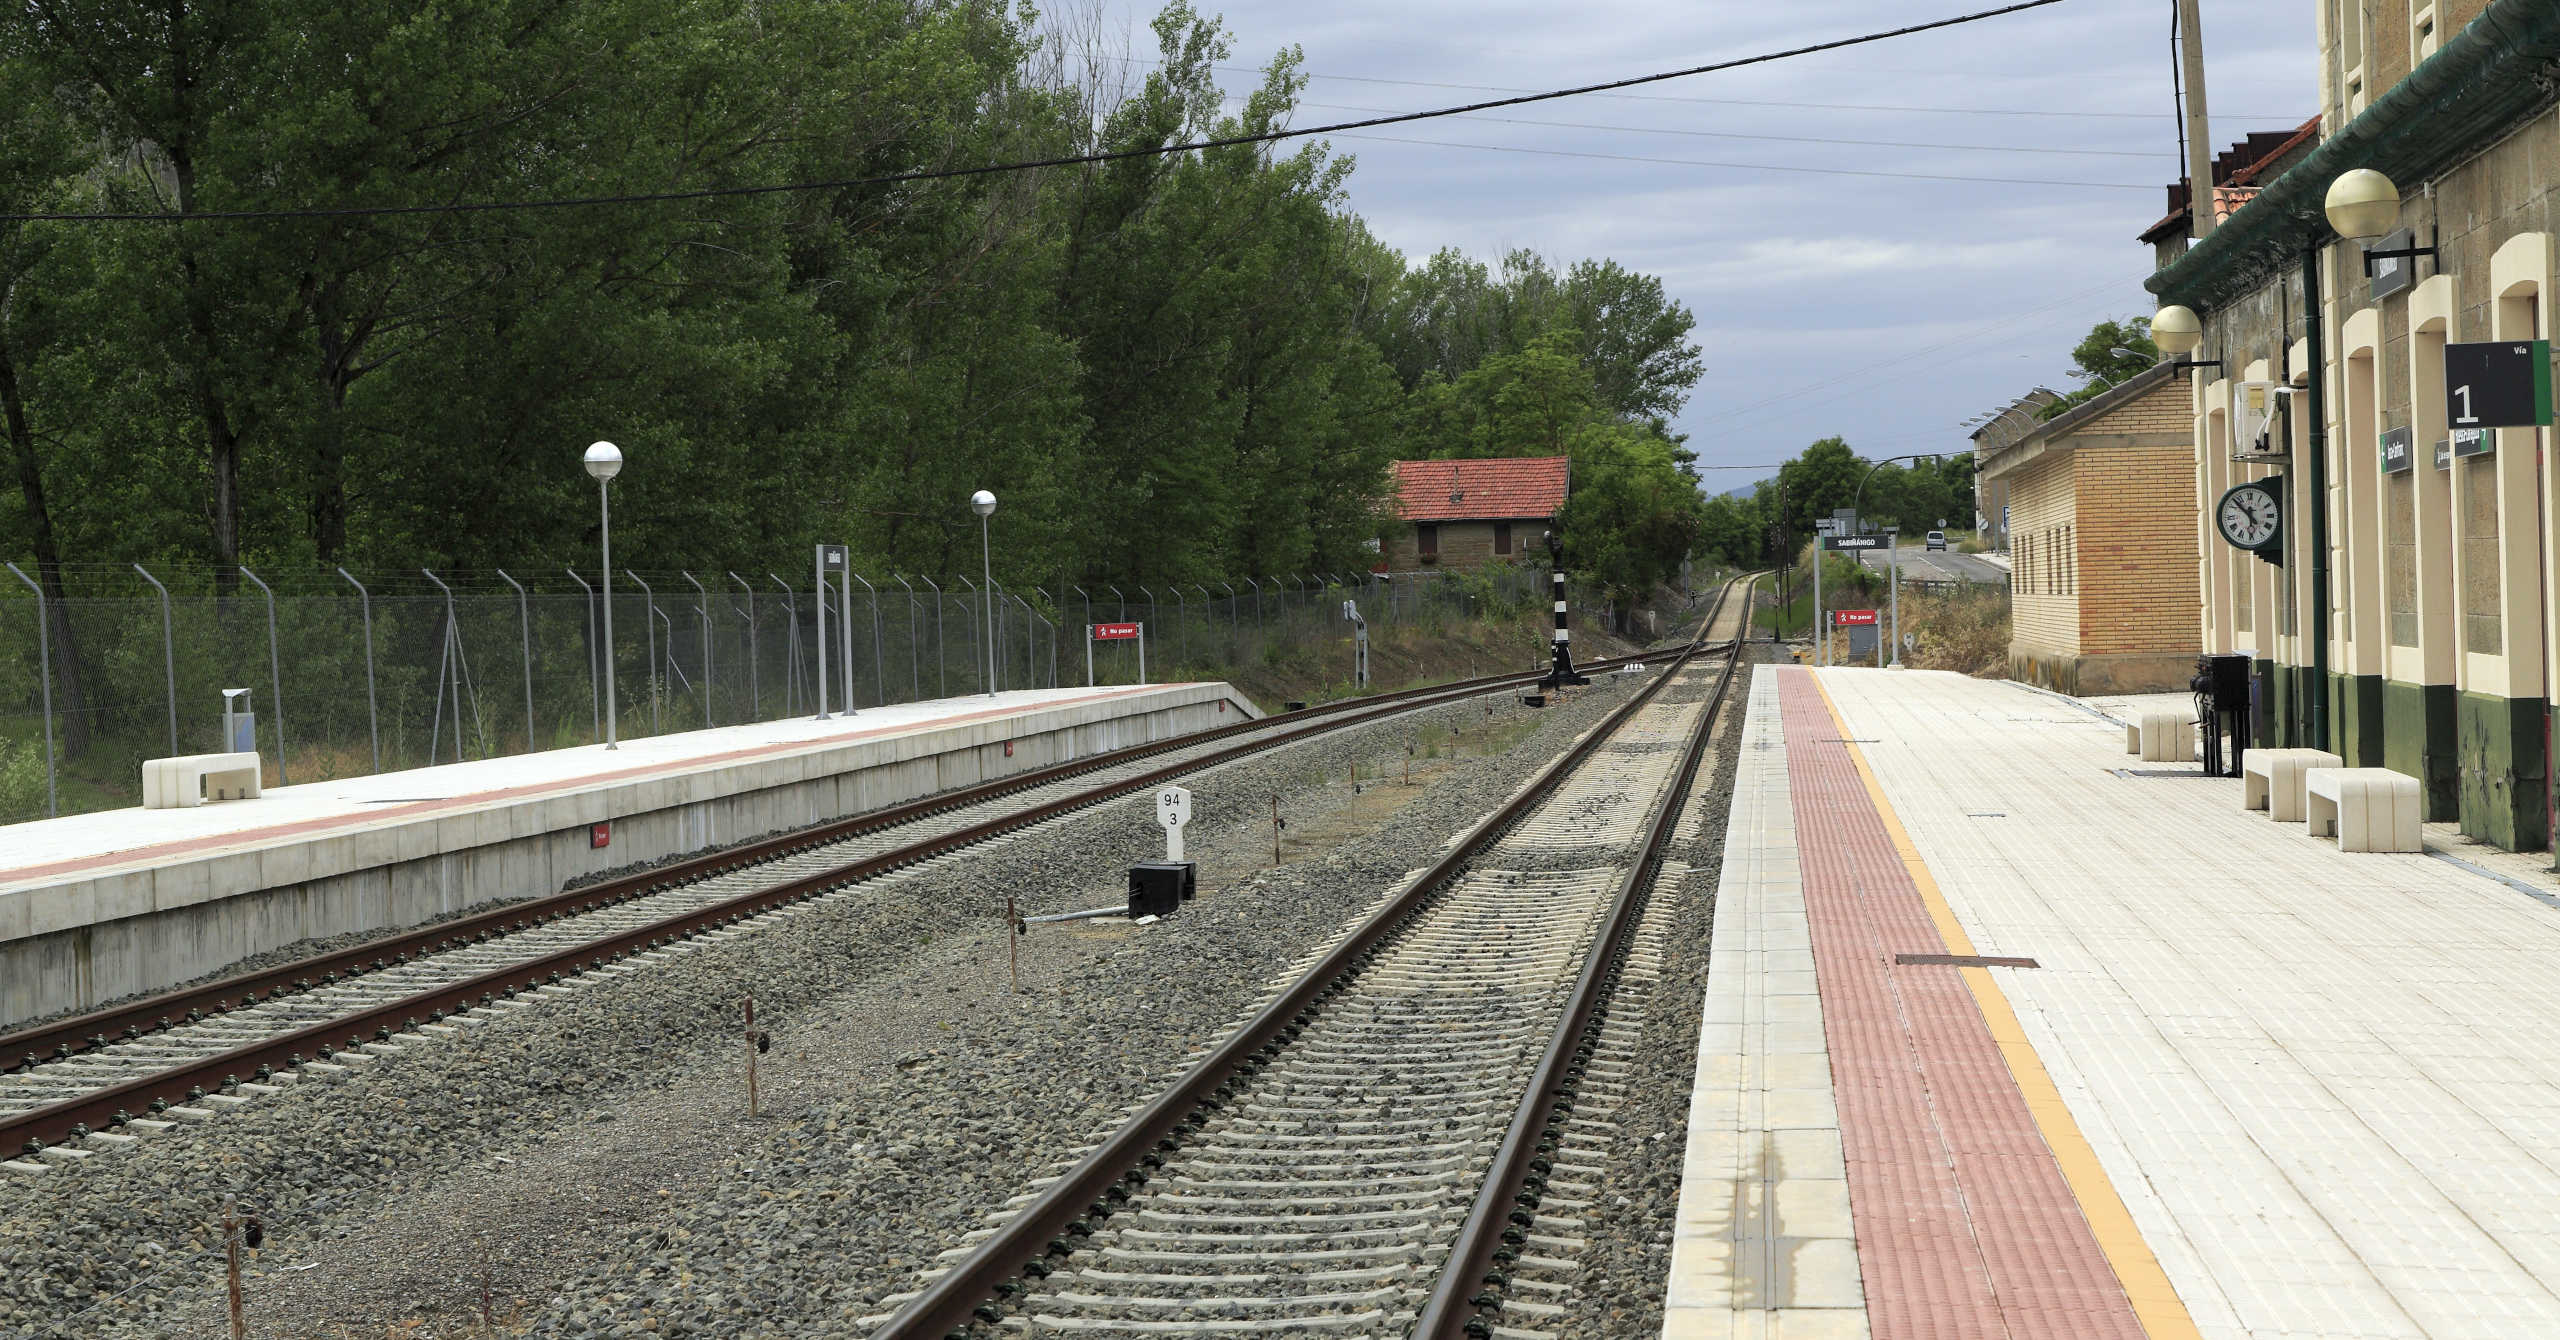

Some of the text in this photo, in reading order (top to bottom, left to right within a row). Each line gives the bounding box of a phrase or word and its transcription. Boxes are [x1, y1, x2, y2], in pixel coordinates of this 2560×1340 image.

[2513, 345, 2527, 355] Vía
[2454, 384, 2479, 424] 1
[1164, 793, 1180, 806] 94
[1169, 812, 1177, 825] 3
